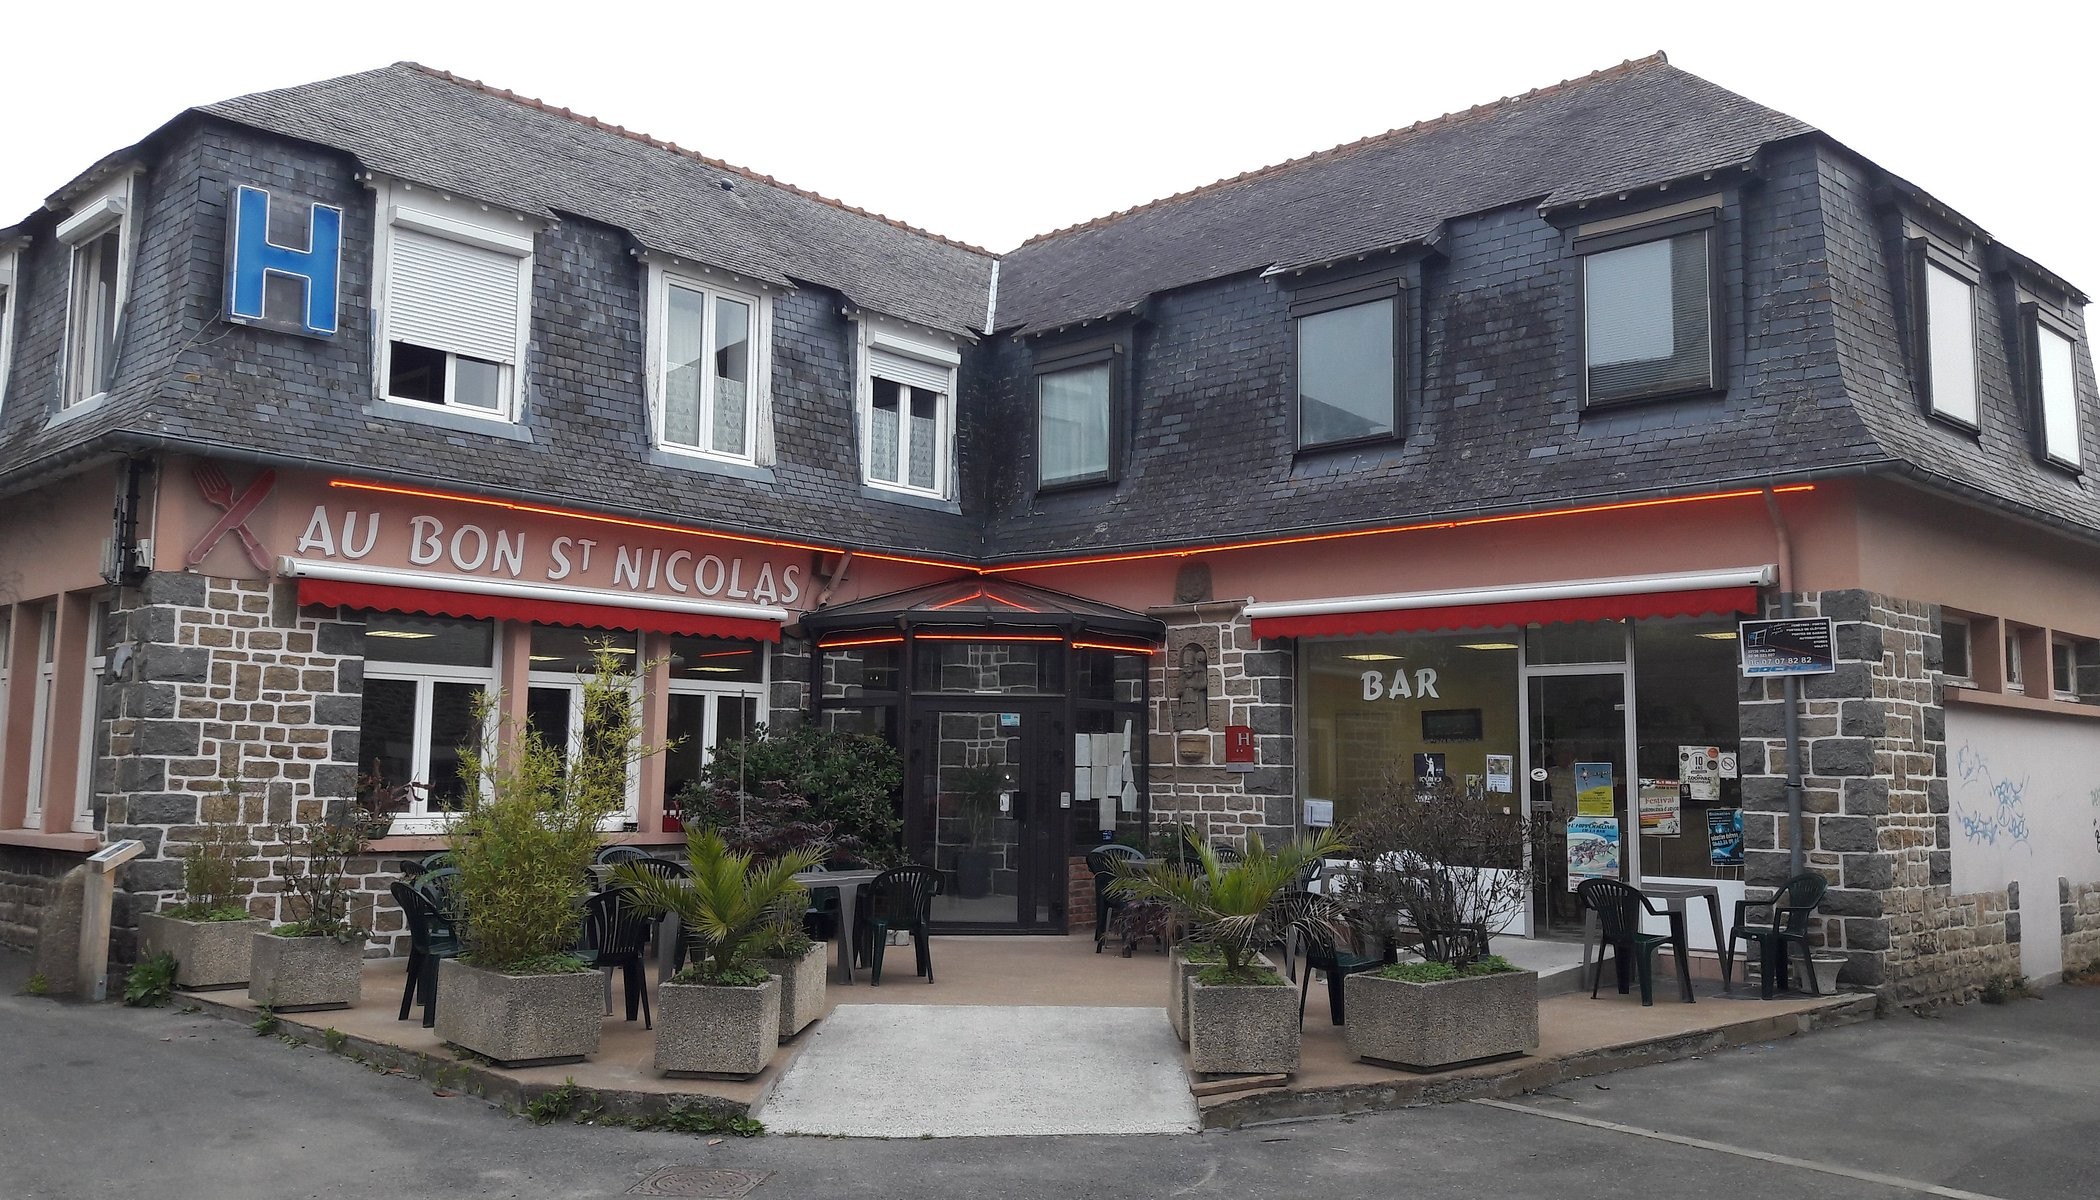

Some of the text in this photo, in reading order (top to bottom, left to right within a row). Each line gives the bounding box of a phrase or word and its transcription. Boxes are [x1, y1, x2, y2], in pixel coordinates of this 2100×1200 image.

[232, 185, 343, 333] H
[298, 505, 380, 560] AU
[407, 514, 526, 578] BON
[613, 545, 801, 605] NICOLAS
[1361, 668, 1440, 701] BAR
[1238, 732, 1250, 746] H
[1694, 756, 1703, 766] 10
[1646, 796, 1674, 804] Festival
